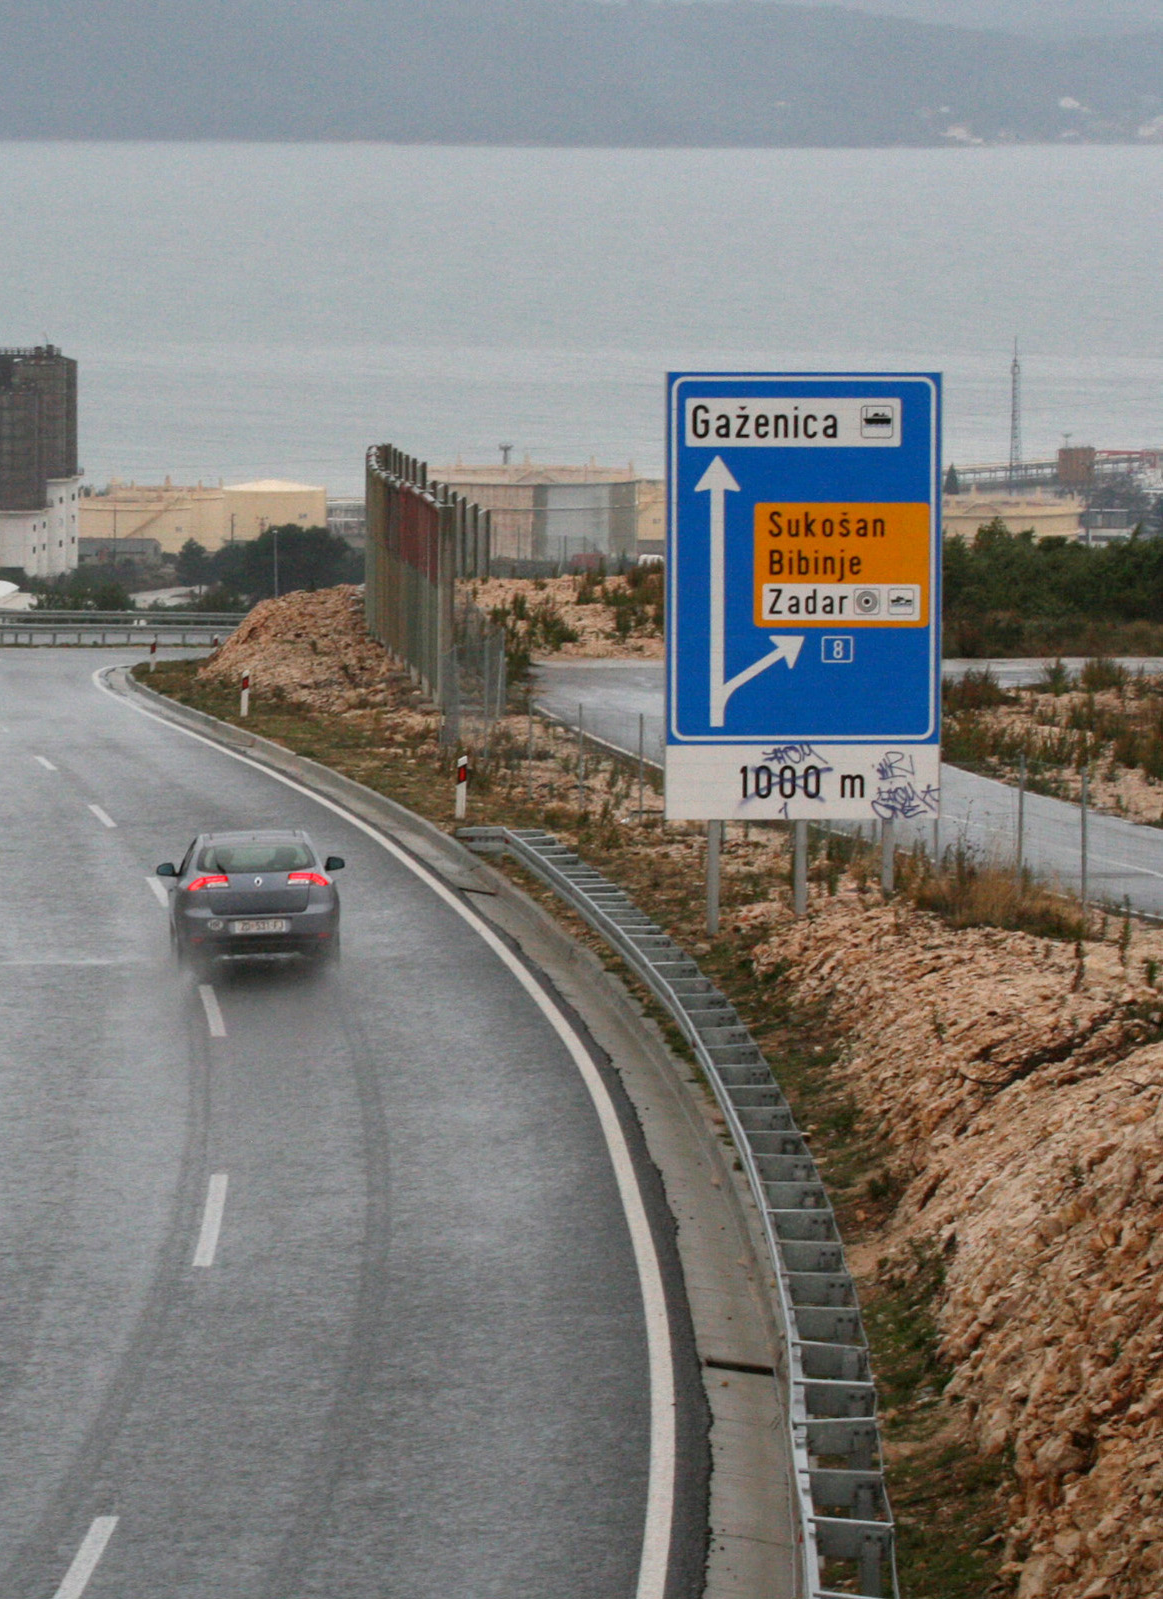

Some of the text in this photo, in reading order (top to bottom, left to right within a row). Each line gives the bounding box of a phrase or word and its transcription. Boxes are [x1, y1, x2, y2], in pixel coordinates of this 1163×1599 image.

[692, 404, 838, 439] Gaženica
[768, 511, 886, 539] Sukošan
[768, 549, 862, 582] Bibinje
[769, 588, 848, 615] Zadar
[832, 640, 844, 659] 8
[739, 765, 865, 799] 1000 m
